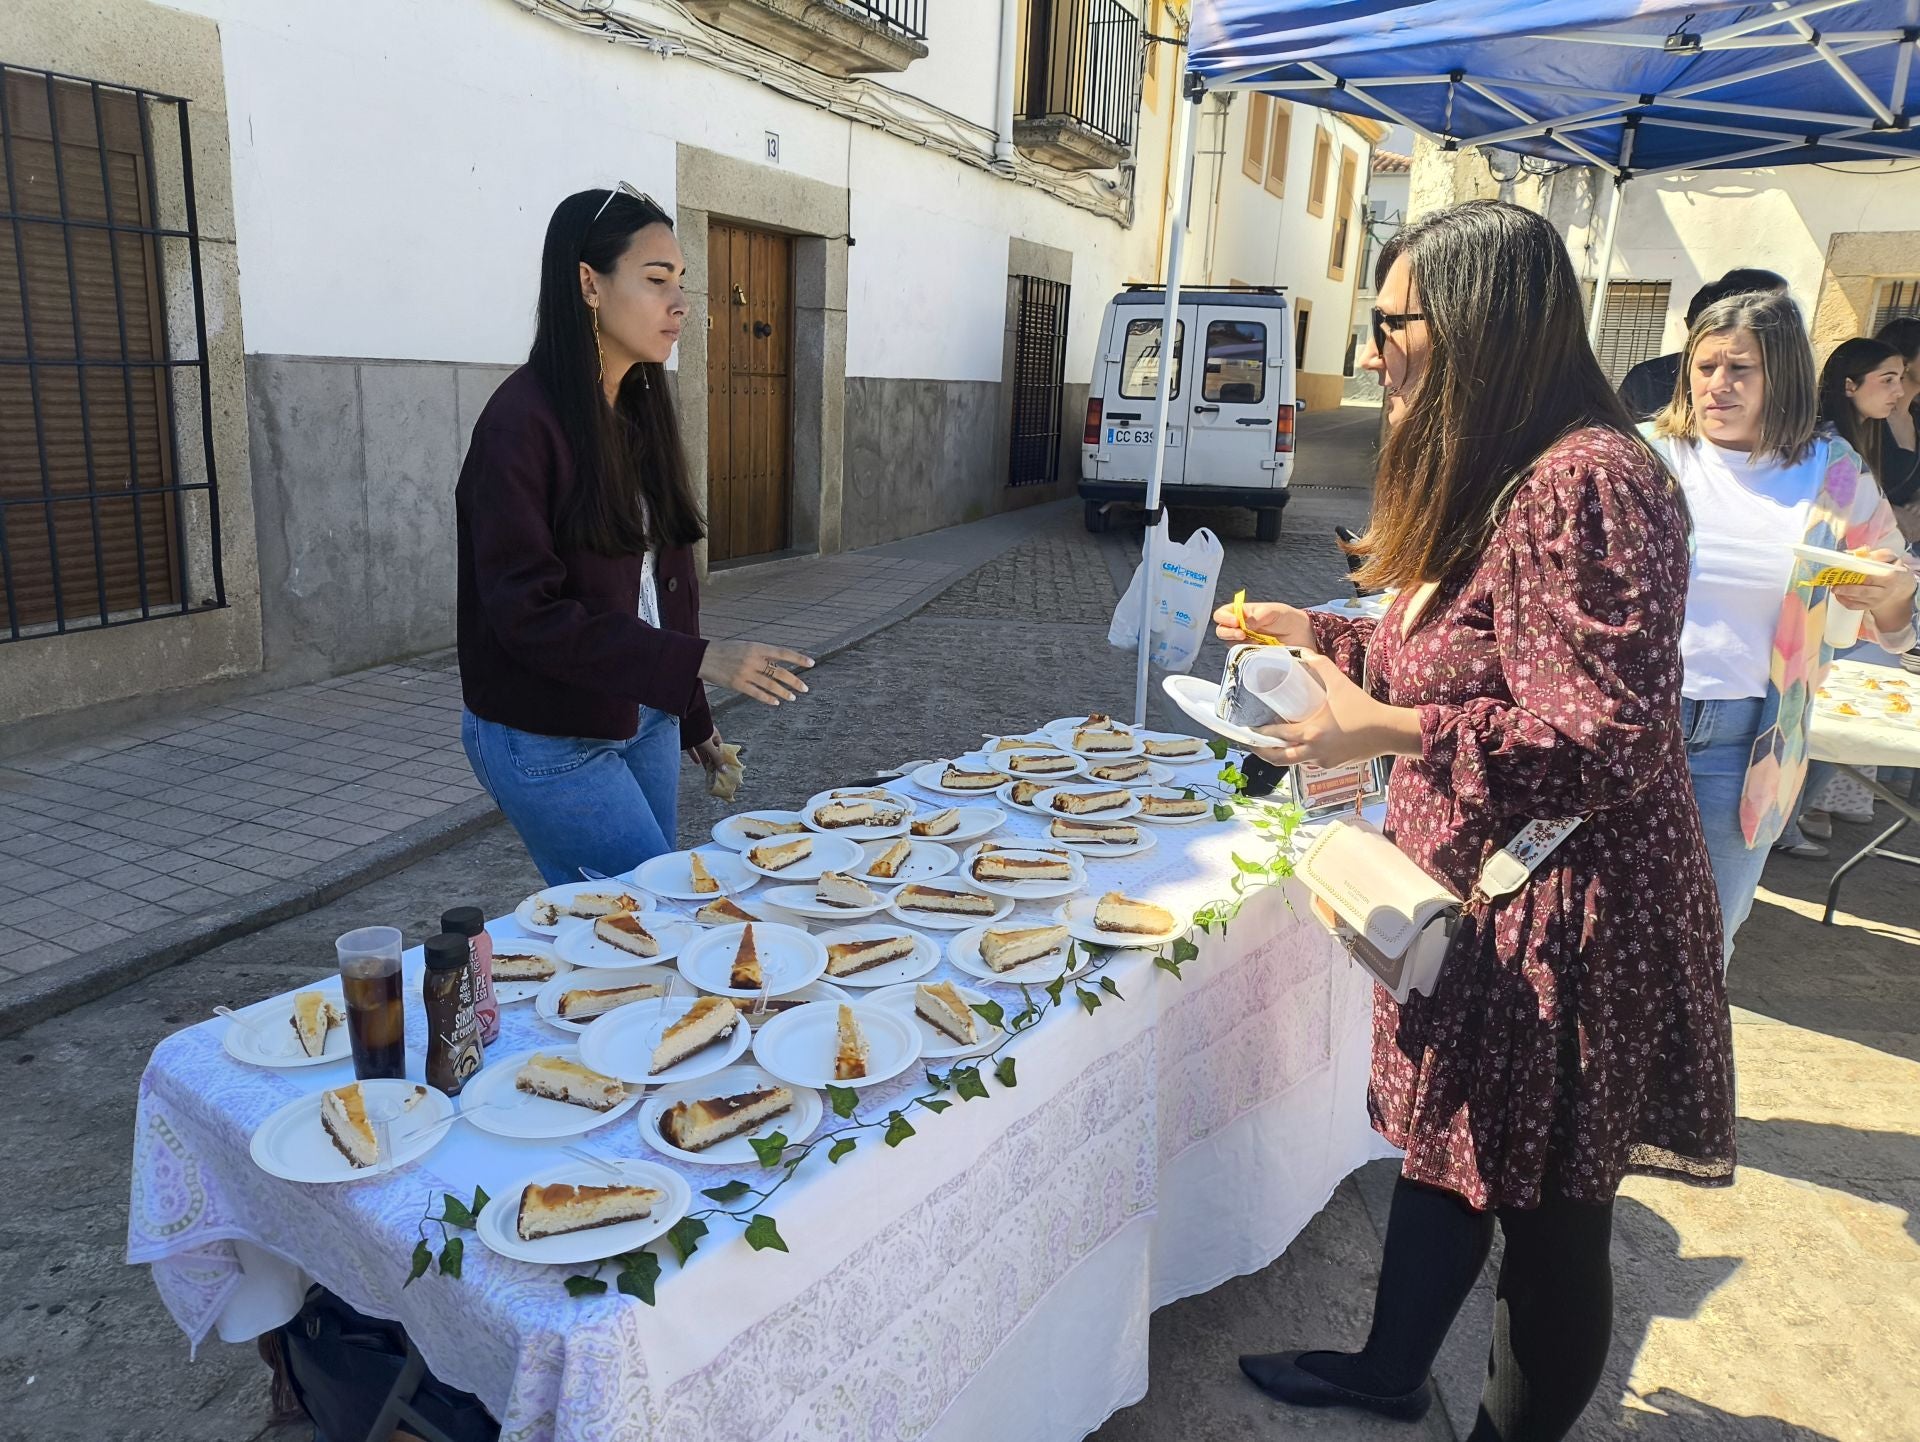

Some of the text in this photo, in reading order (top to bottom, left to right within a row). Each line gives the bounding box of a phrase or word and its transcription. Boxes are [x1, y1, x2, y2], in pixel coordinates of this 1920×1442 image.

[767, 138, 777, 158] 13
[1115, 430, 1131, 443] CC
[1185, 569, 1208, 584] FRESH
[475, 989, 488, 1003] ESA
[451, 1030, 459, 1043] DE
